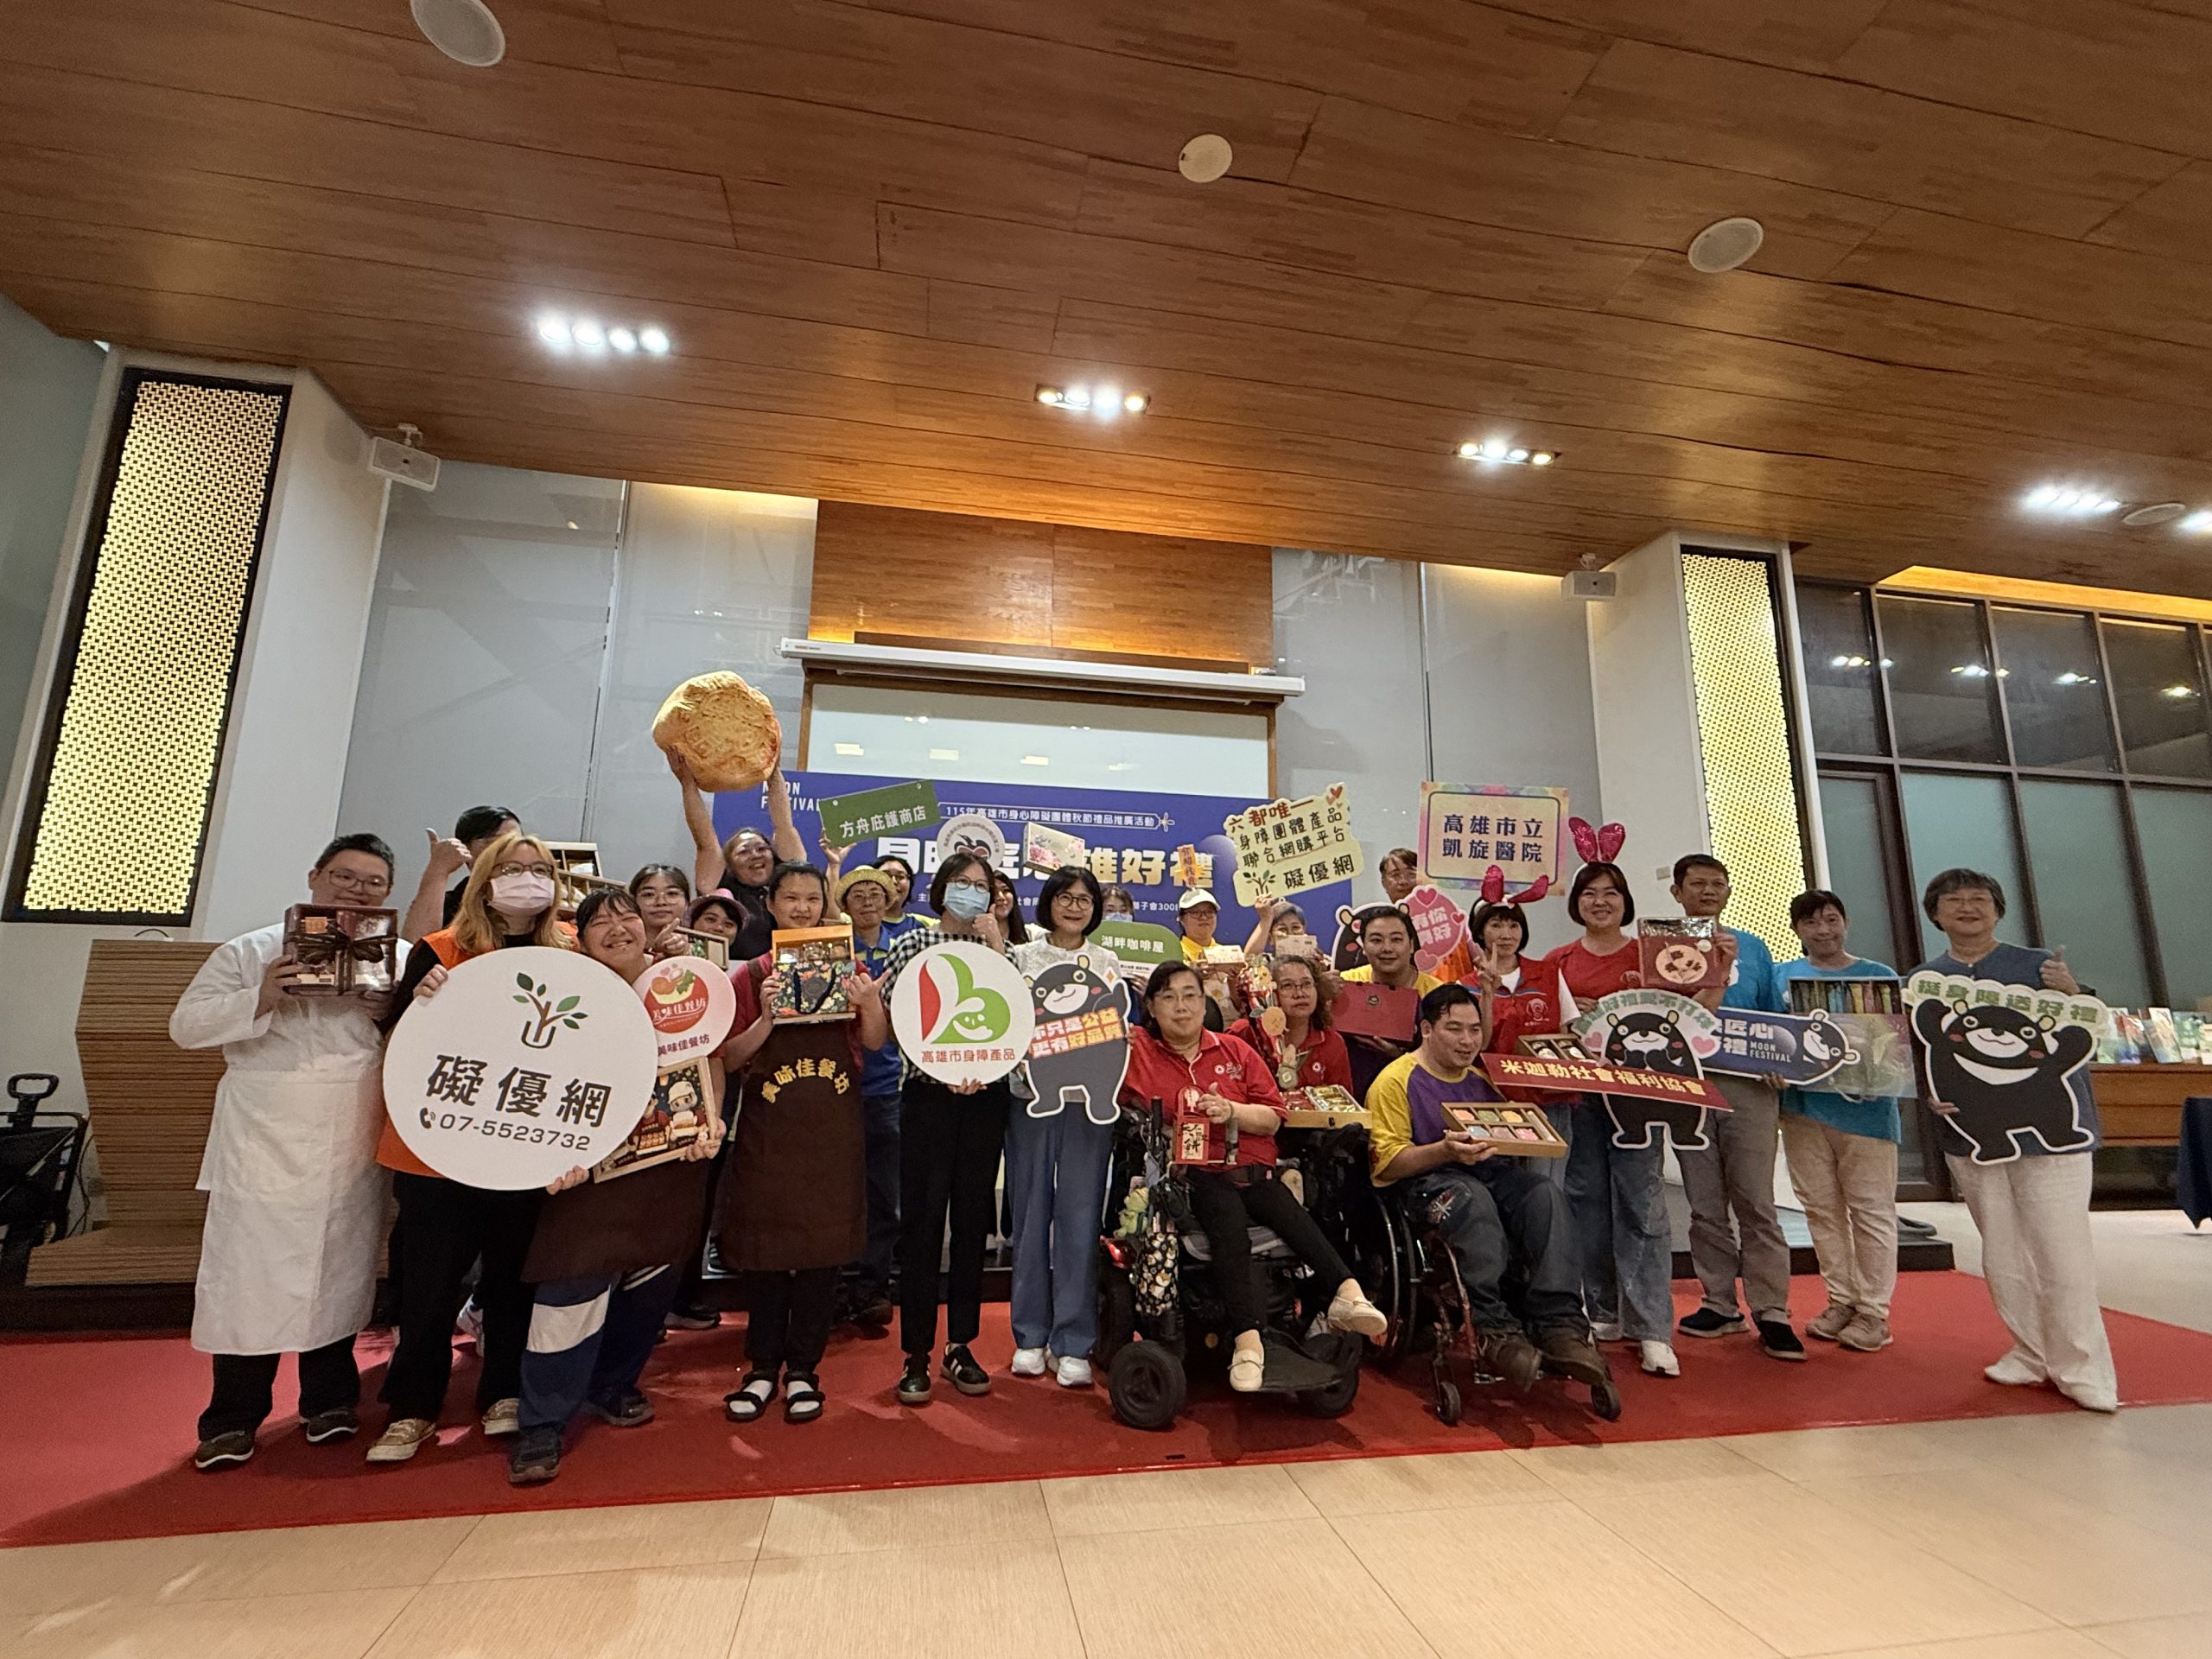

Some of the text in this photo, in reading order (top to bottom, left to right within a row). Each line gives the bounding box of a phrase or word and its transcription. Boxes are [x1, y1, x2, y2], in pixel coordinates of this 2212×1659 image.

[762, 780, 801, 795] MON
[760, 795, 821, 812] FIVAL
[839, 805, 927, 838] 方舟庇護商店
[1229, 799, 1313, 833] 六都唯一
[1443, 814, 1543, 838] 高雄市立
[1239, 808, 1342, 850] 身障團體產品
[1243, 826, 1345, 868] 聯合網購平台
[1442, 838, 1542, 862] 凱旋醫院
[1283, 854, 1355, 889] 礙優網
[1101, 934, 1165, 953] 湖畔咖啡屋
[1715, 1018, 1774, 1039] 匠心
[658, 1034, 710, 1055] 美味佳餐坊
[921, 1048, 1015, 1064] 高雄市身障產品
[1750, 1041, 1777, 1052] MOON
[1750, 1050, 1792, 1063] FESTIVAL
[761, 1058, 850, 1104] 美味佳餐坊
[1500, 1058, 1707, 1096] 米迦勒社會福利協會
[426, 1054, 612, 1128] 礙優網
[438, 1113, 591, 1151] 07-5523732
